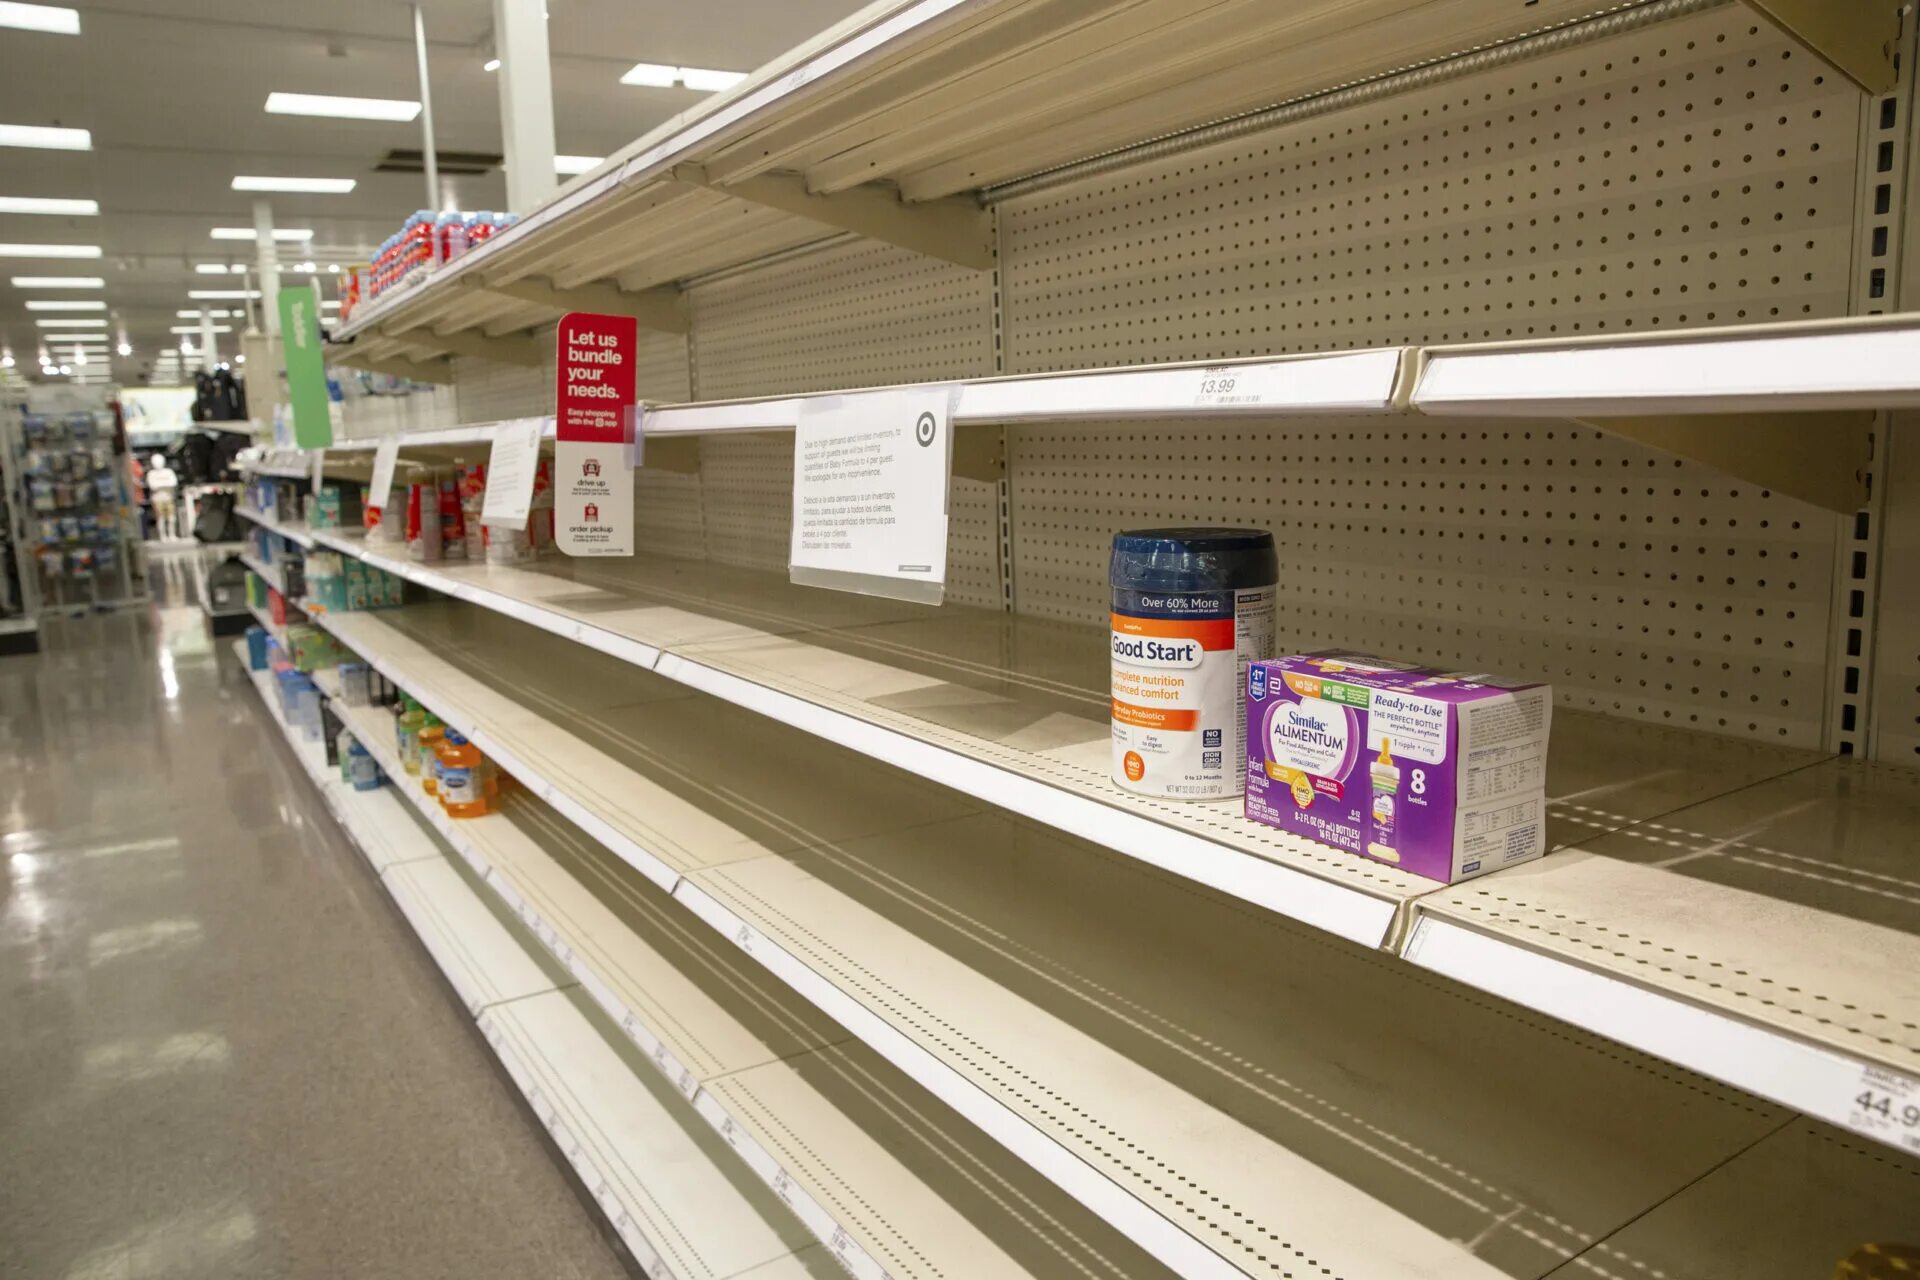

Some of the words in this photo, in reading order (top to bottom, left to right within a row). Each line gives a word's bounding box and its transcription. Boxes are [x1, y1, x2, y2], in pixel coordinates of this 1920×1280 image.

[568, 328, 595, 346] Let
[598, 334, 618, 348] us
[568, 346, 622, 365] bundle
[568, 367, 604, 382] your
[568, 383, 620, 399] needs.
[1200, 379, 1236, 394] 13.99
[584, 408, 616, 419] shopping
[590, 526, 614, 534] pickup
[1142, 596, 1164, 608] Over
[1166, 598, 1188, 608] 60%
[1191, 598, 1220, 608] More
[1113, 636, 1144, 658] Good
[1147, 642, 1194, 662] Start
[1142, 674, 1184, 686] nutrition
[1140, 688, 1180, 700] comfort
[1375, 694, 1443, 718] Ready-to-Use
[1132, 708, 1166, 721] Probiotics
[1288, 710, 1326, 732] Similac
[1374, 710, 1386, 718] THE
[1386, 713, 1414, 724] PERFECT
[1415, 718, 1440, 730] BOTTLE
[1274, 723, 1343, 751] ALIMENTUM
[1390, 722, 1416, 734] anywhere,
[1417, 729, 1440, 738] anytime
[1286, 740, 1297, 748] Food
[1298, 742, 1315, 753] Allergies
[1248, 756, 1263, 772] Infant
[1248, 769, 1269, 788] Formula
[1411, 768, 1426, 794] 8
[1296, 787, 1310, 795] HMO
[1408, 794, 1428, 806] bottles
[1294, 811, 1303, 822] 8-2
[1304, 813, 1309, 824] FL
[1310, 816, 1316, 827] OZ
[1325, 831, 1331, 840] FL
[1332, 833, 1339, 843] OZ
